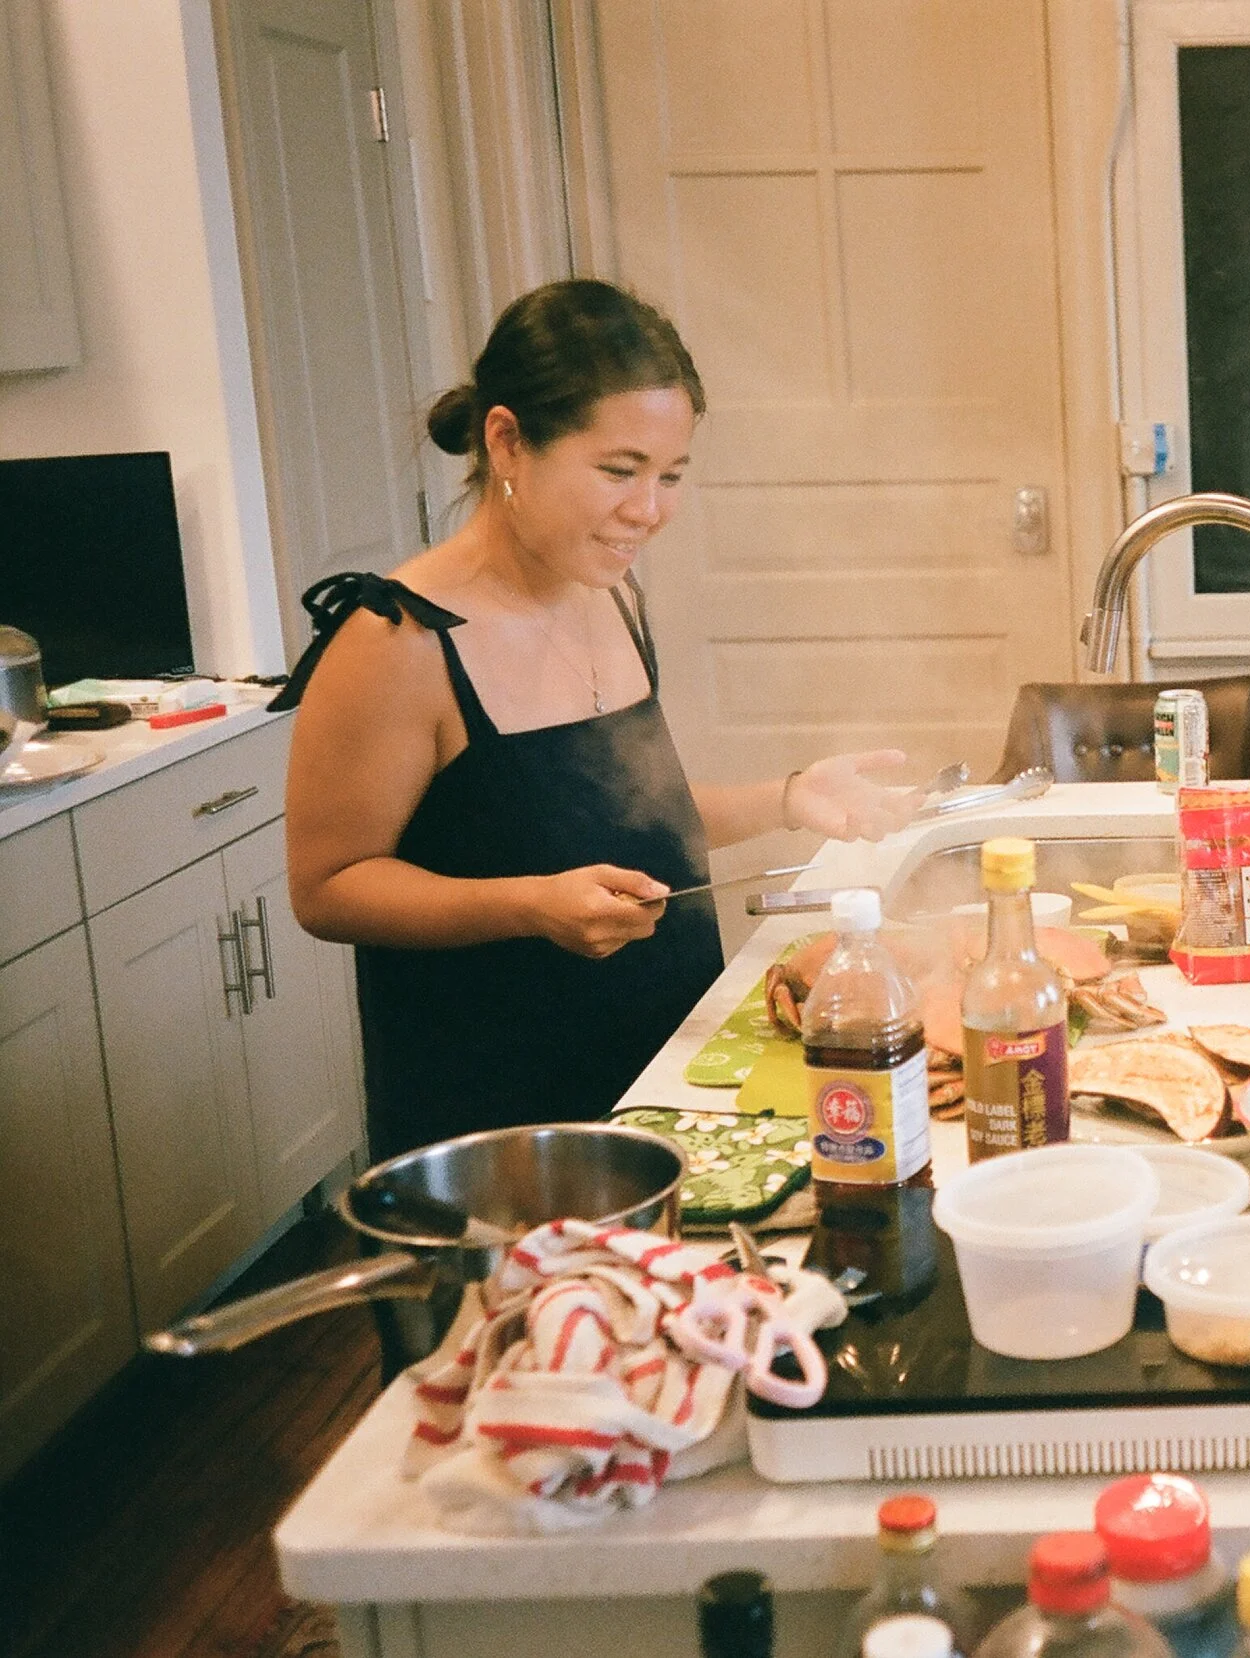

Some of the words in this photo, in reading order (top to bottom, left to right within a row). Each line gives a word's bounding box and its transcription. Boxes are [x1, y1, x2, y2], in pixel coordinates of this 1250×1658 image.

[985, 1104, 1016, 1118] LABEL
[989, 1118, 1017, 1131] DARK
[984, 1132, 1017, 1146] SAUCE
